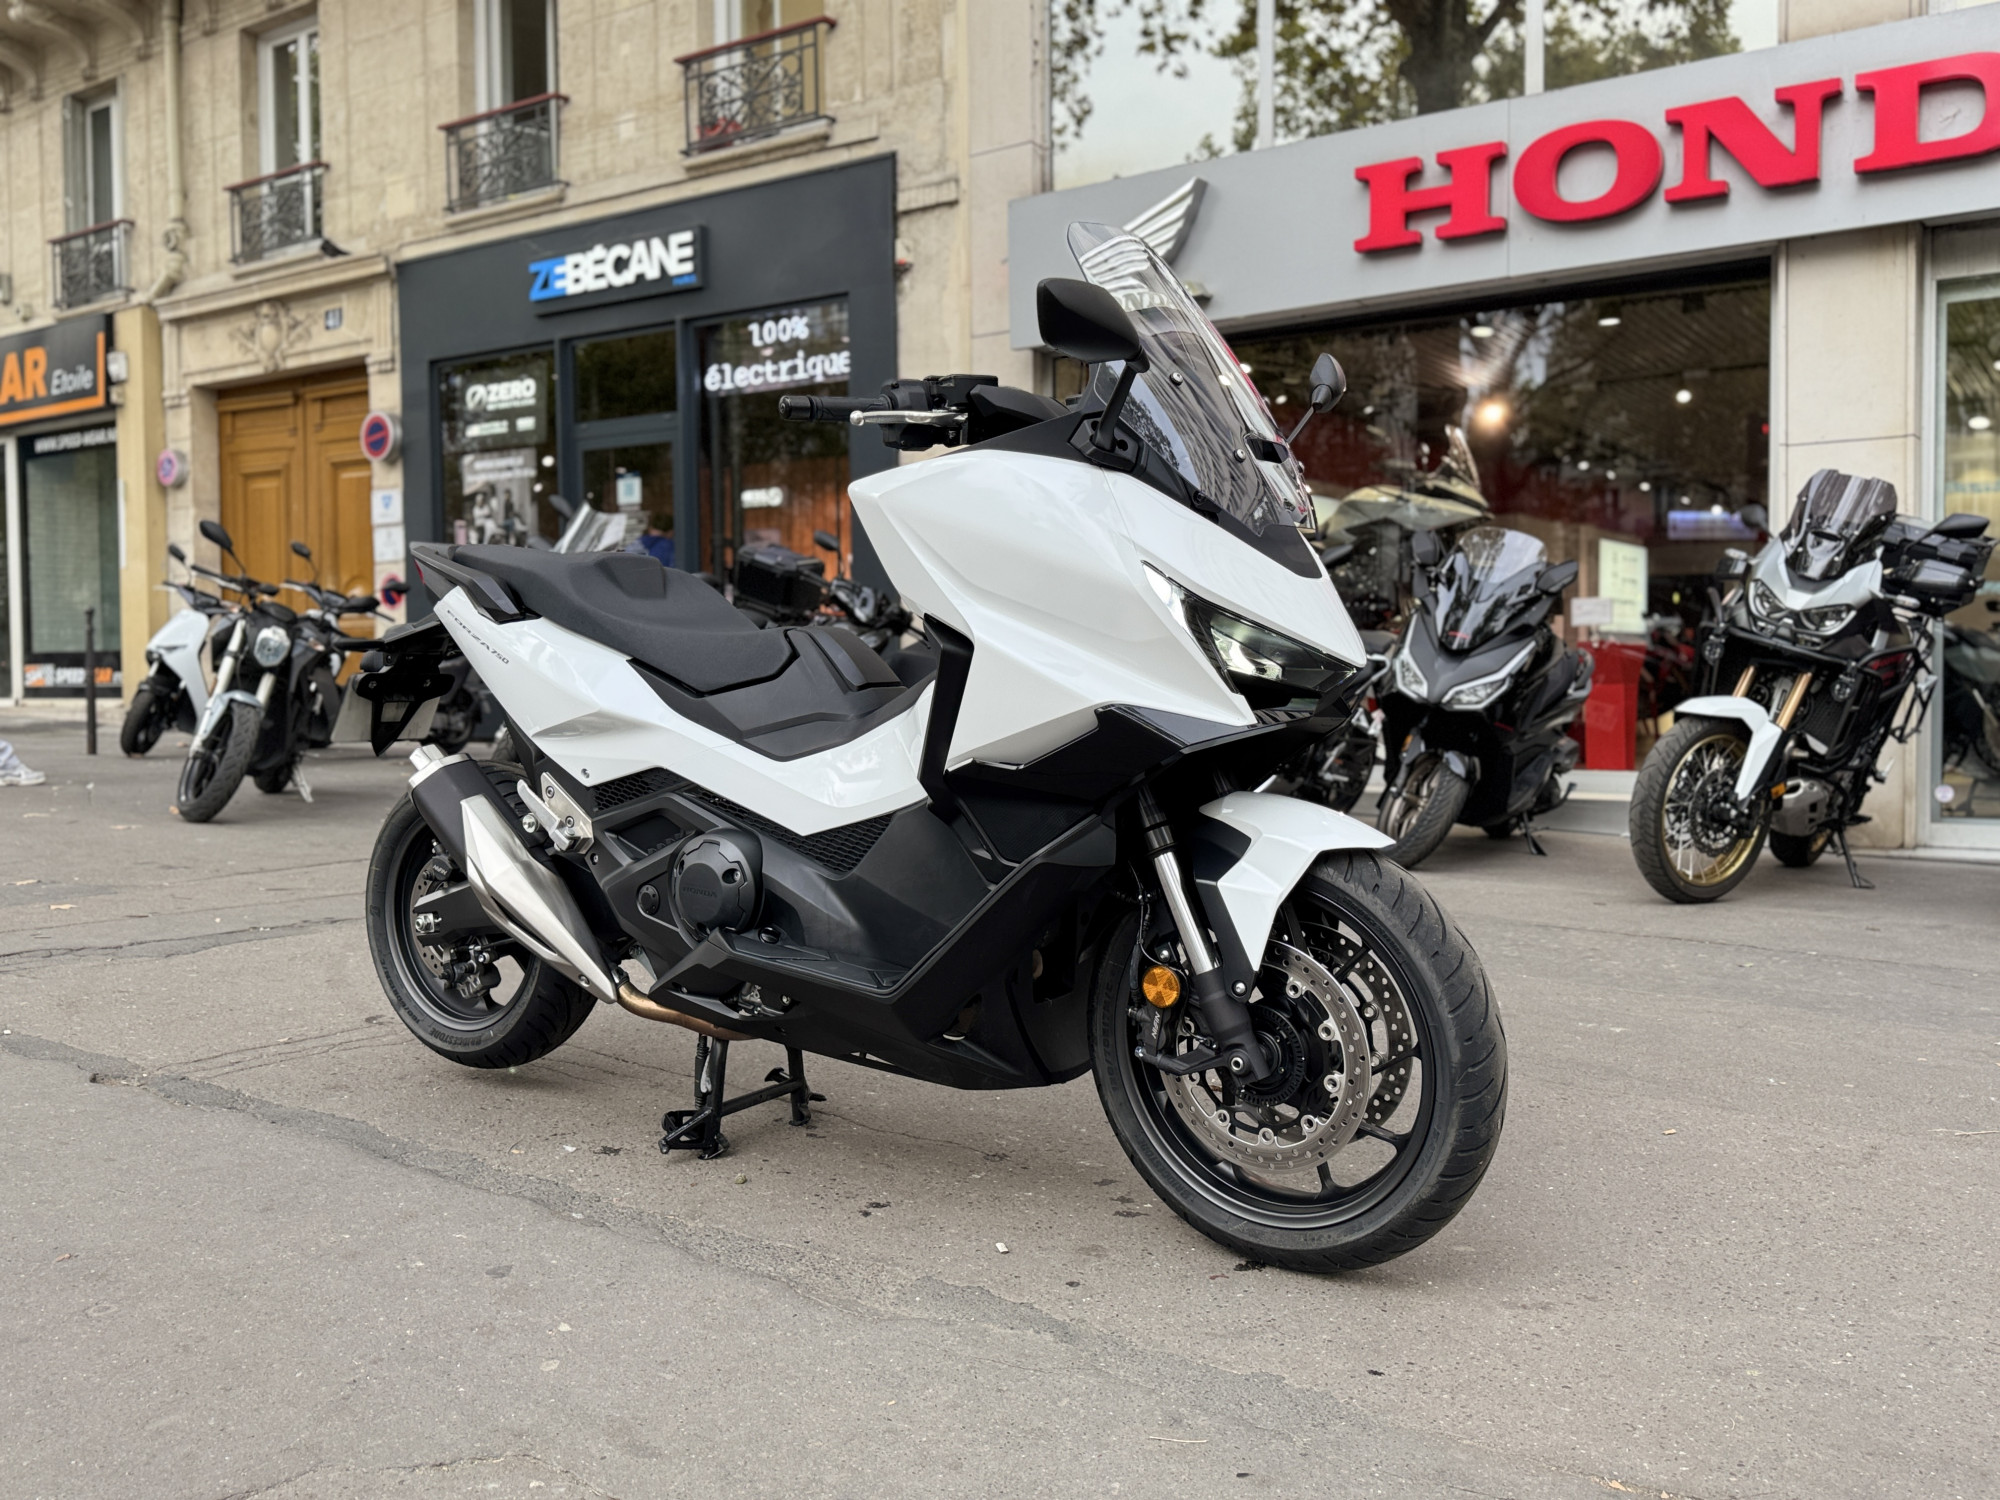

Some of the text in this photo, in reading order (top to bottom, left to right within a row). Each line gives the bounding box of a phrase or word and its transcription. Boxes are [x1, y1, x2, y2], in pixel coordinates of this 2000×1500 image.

[747, 315, 810, 348] 100%
[704, 349, 851, 392] électrique
[486, 378, 537, 402] ZERO
